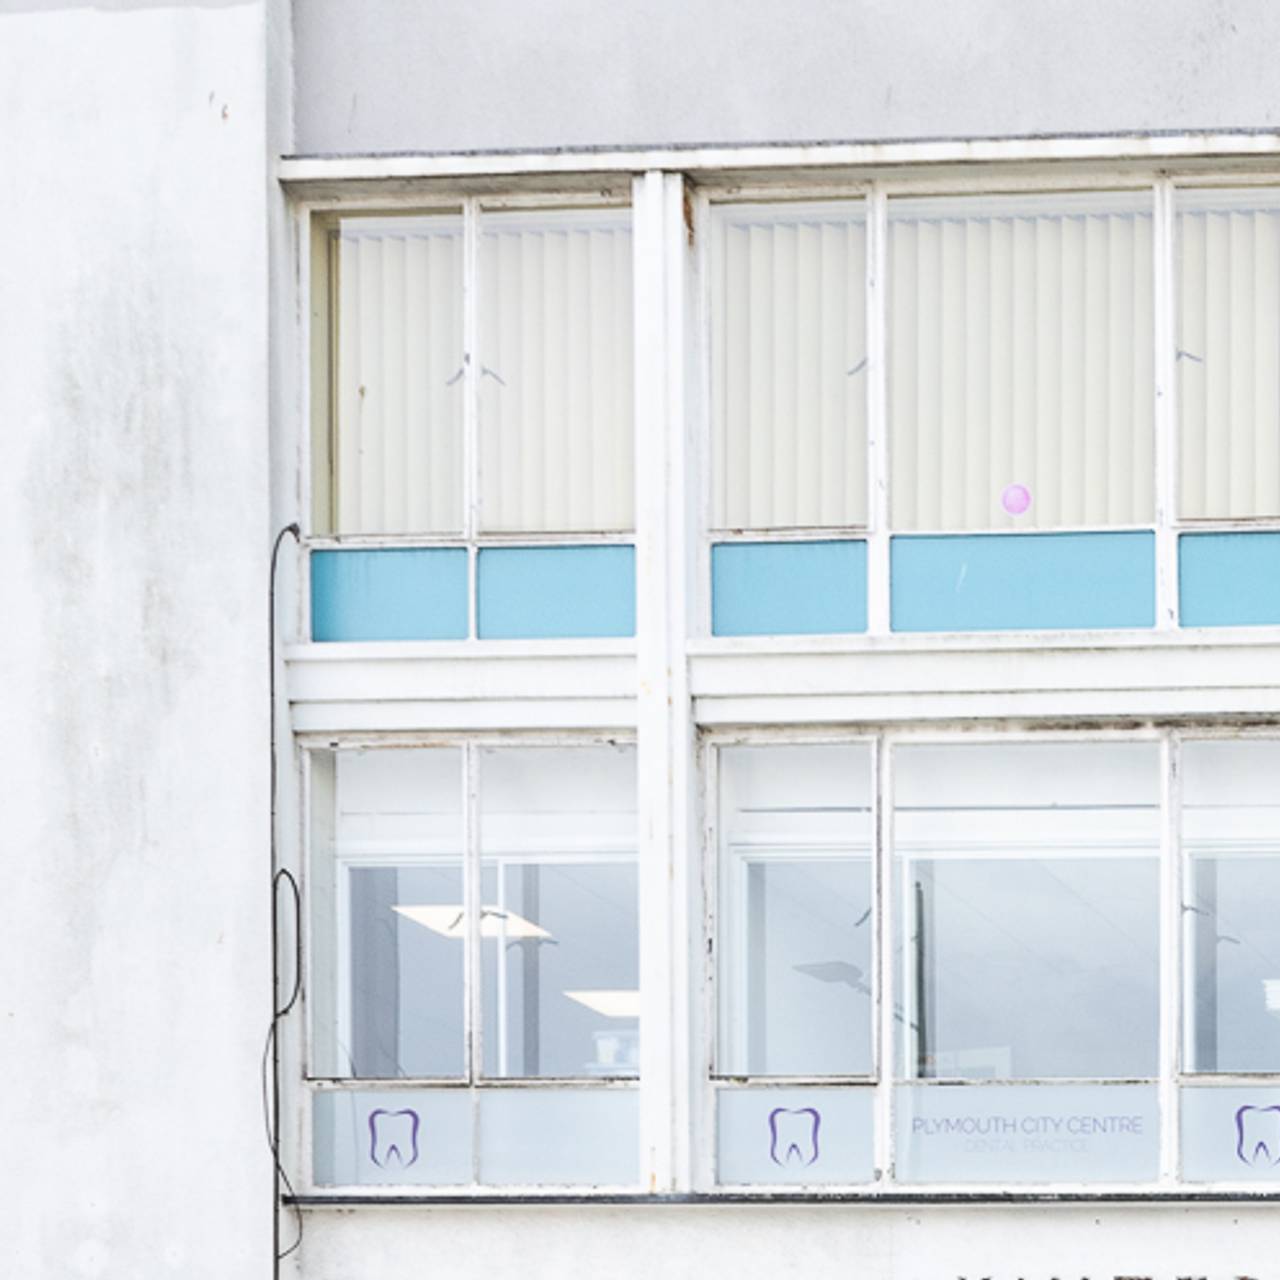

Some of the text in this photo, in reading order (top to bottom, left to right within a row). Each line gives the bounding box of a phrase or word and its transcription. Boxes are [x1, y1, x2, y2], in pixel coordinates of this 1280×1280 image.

[911, 1115, 1144, 1135] PLYMOUTH CITY CENTRE
